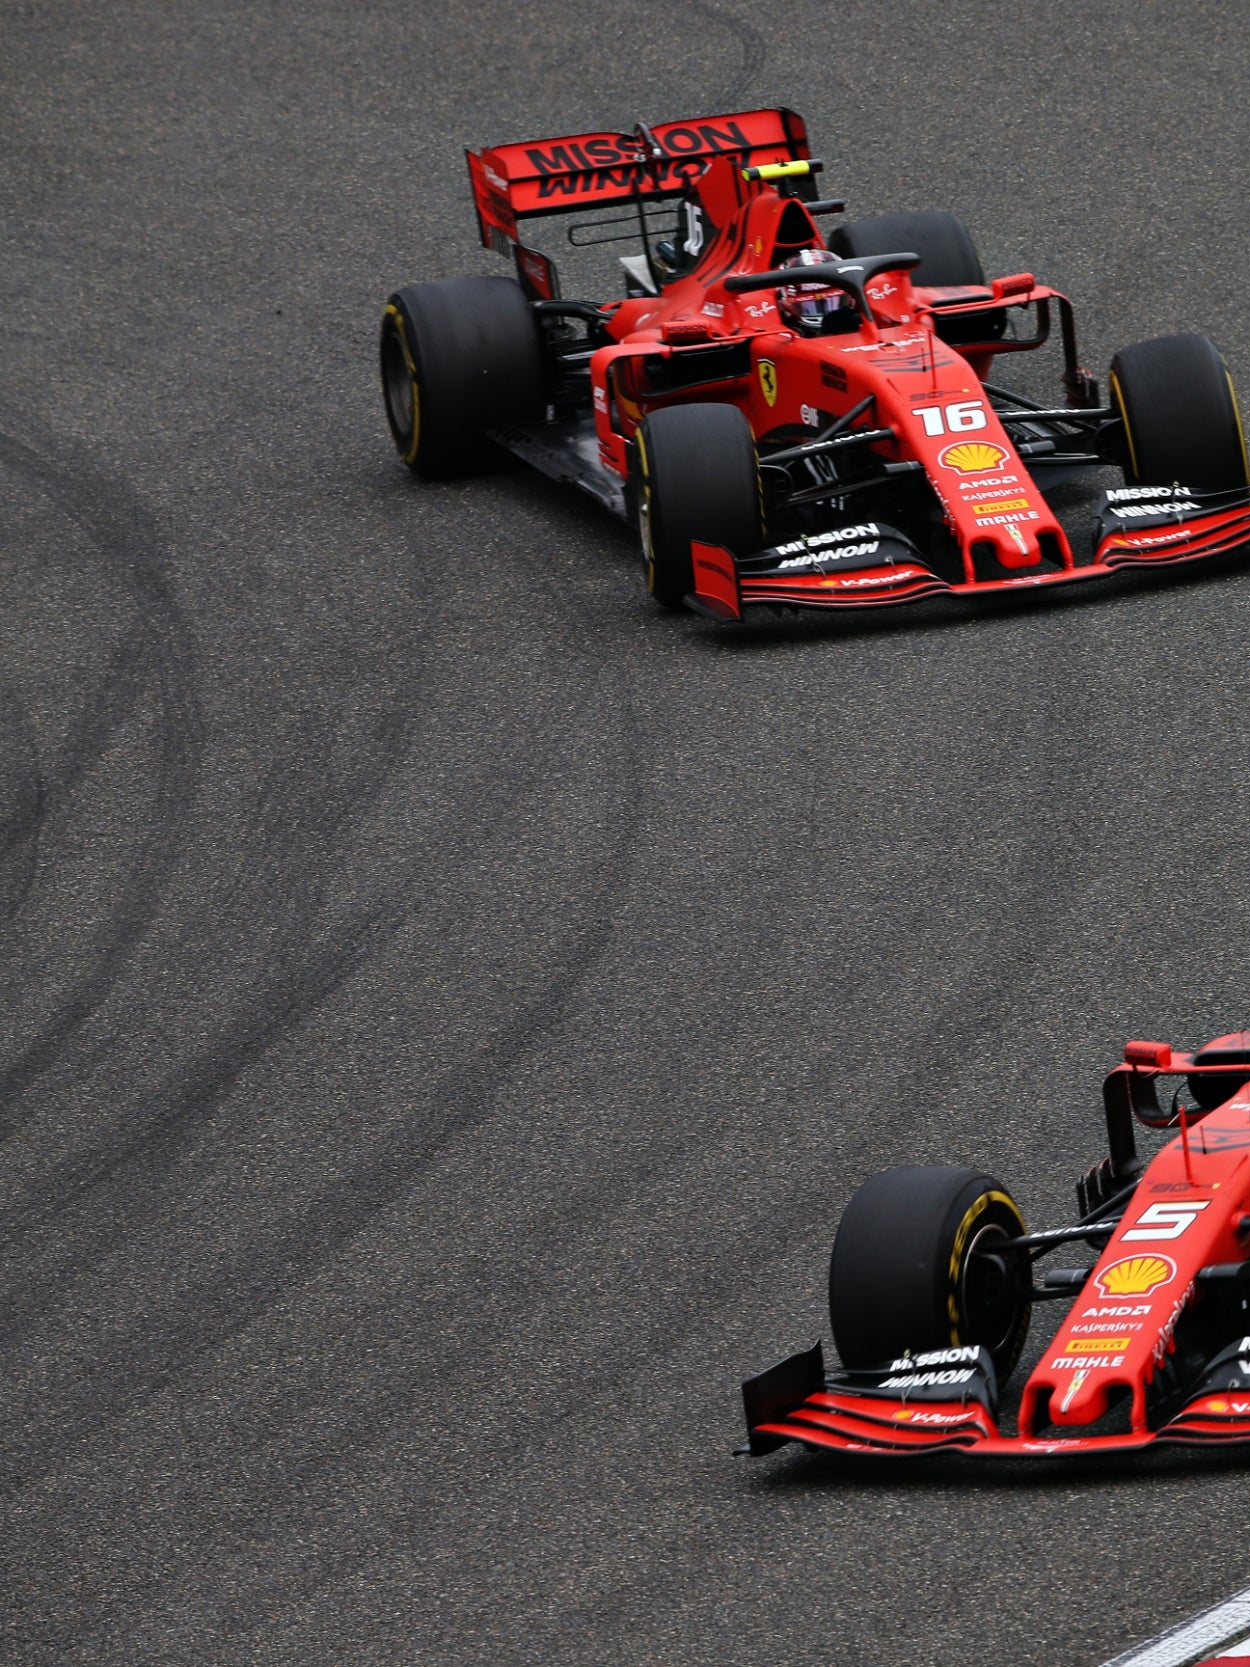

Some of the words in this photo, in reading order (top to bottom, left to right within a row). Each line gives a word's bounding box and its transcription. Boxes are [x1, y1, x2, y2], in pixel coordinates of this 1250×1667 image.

[912, 400, 988, 437] 16
[959, 477, 1004, 490] AMD
[1106, 485, 1193, 502] MISSION
[975, 511, 1040, 527] MAHLE
[775, 522, 880, 556] MISSION
[1128, 529, 1193, 546] V-Power
[841, 571, 914, 587] V-Power
[1119, 1200, 1212, 1242] 5
[1081, 1305, 1134, 1318] AMD
[1071, 1322, 1138, 1334] KASPERSKY
[889, 1345, 980, 1373] MISSION
[1051, 1355, 1126, 1370] MAHLE
[911, 1411, 976, 1424] V-Power
